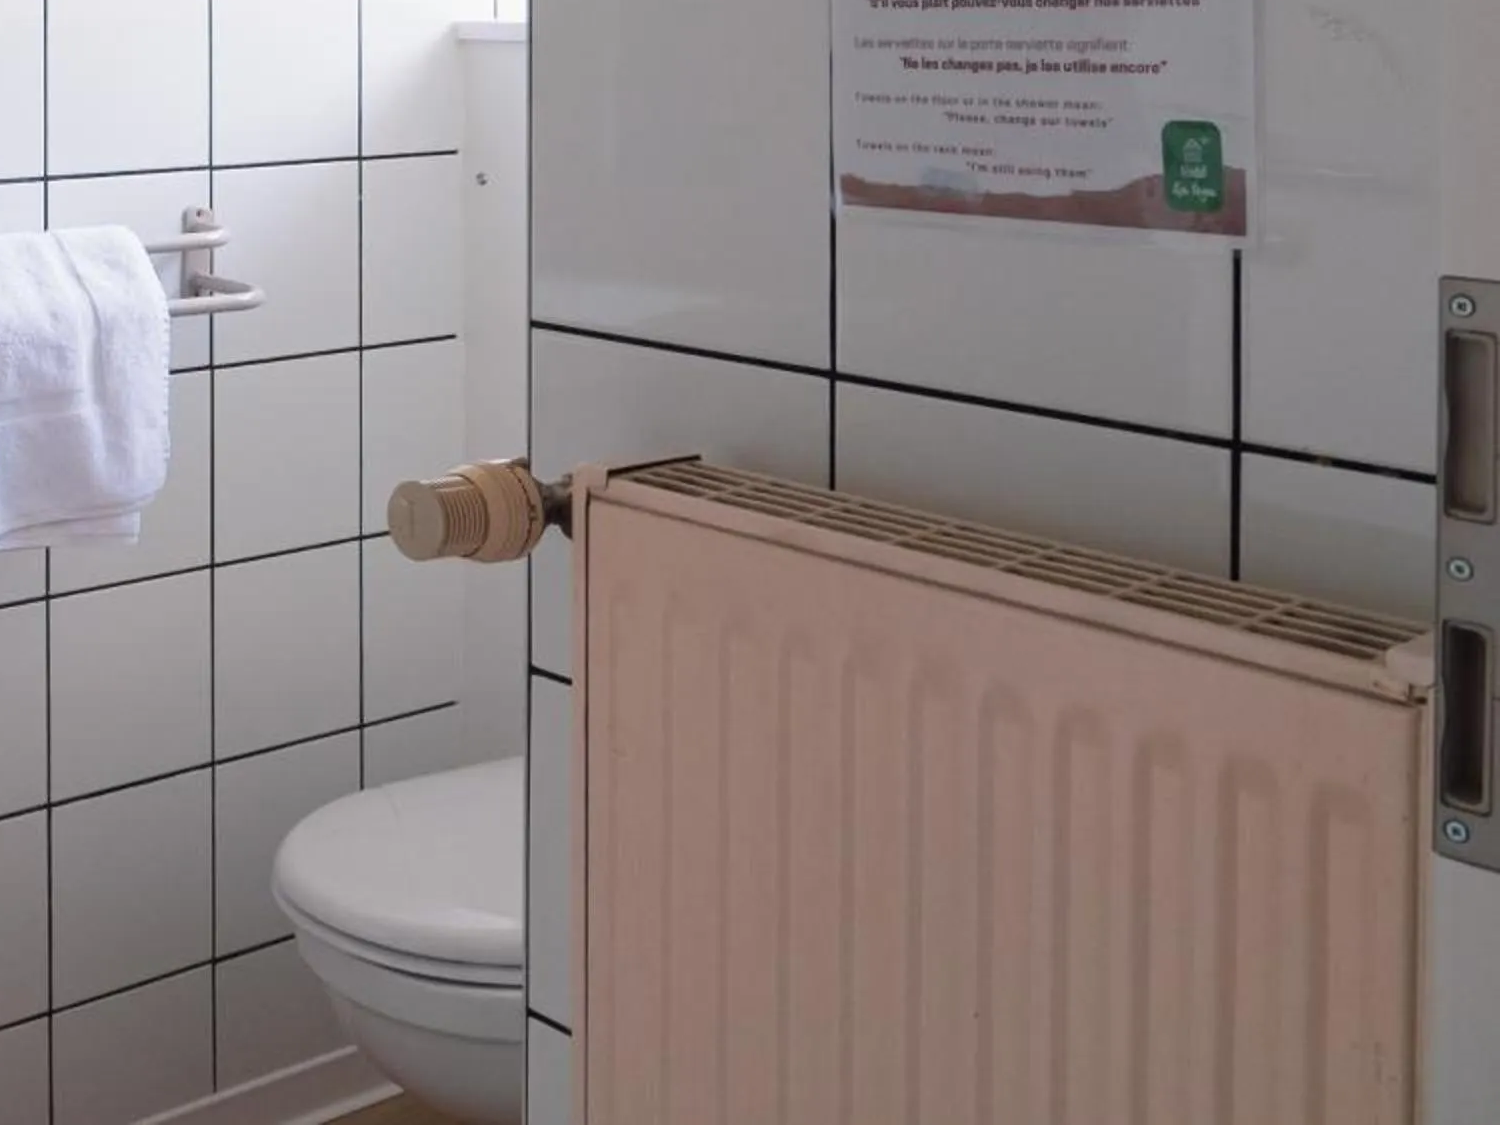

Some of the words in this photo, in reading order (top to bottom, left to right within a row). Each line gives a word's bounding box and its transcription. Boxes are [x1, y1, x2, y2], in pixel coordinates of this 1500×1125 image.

[854, 36, 874, 50] Les
[937, 38, 954, 49] sur
[969, 39, 1003, 51] porte
[921, 56, 940, 69] les
[941, 57, 994, 73] changes
[1025, 58, 1039, 75] je
[1041, 58, 1061, 72] les
[1063, 58, 1108, 73] utilise
[855, 91, 892, 104] Towels
[910, 93, 930, 105] the
[931, 93, 959, 106] floor
[992, 96, 1012, 108] the
[1015, 97, 1059, 109] shower
[993, 114, 1037, 127] change
[912, 142, 930, 153] the
[992, 164, 1015, 175] still
[1017, 166, 1052, 180] using
